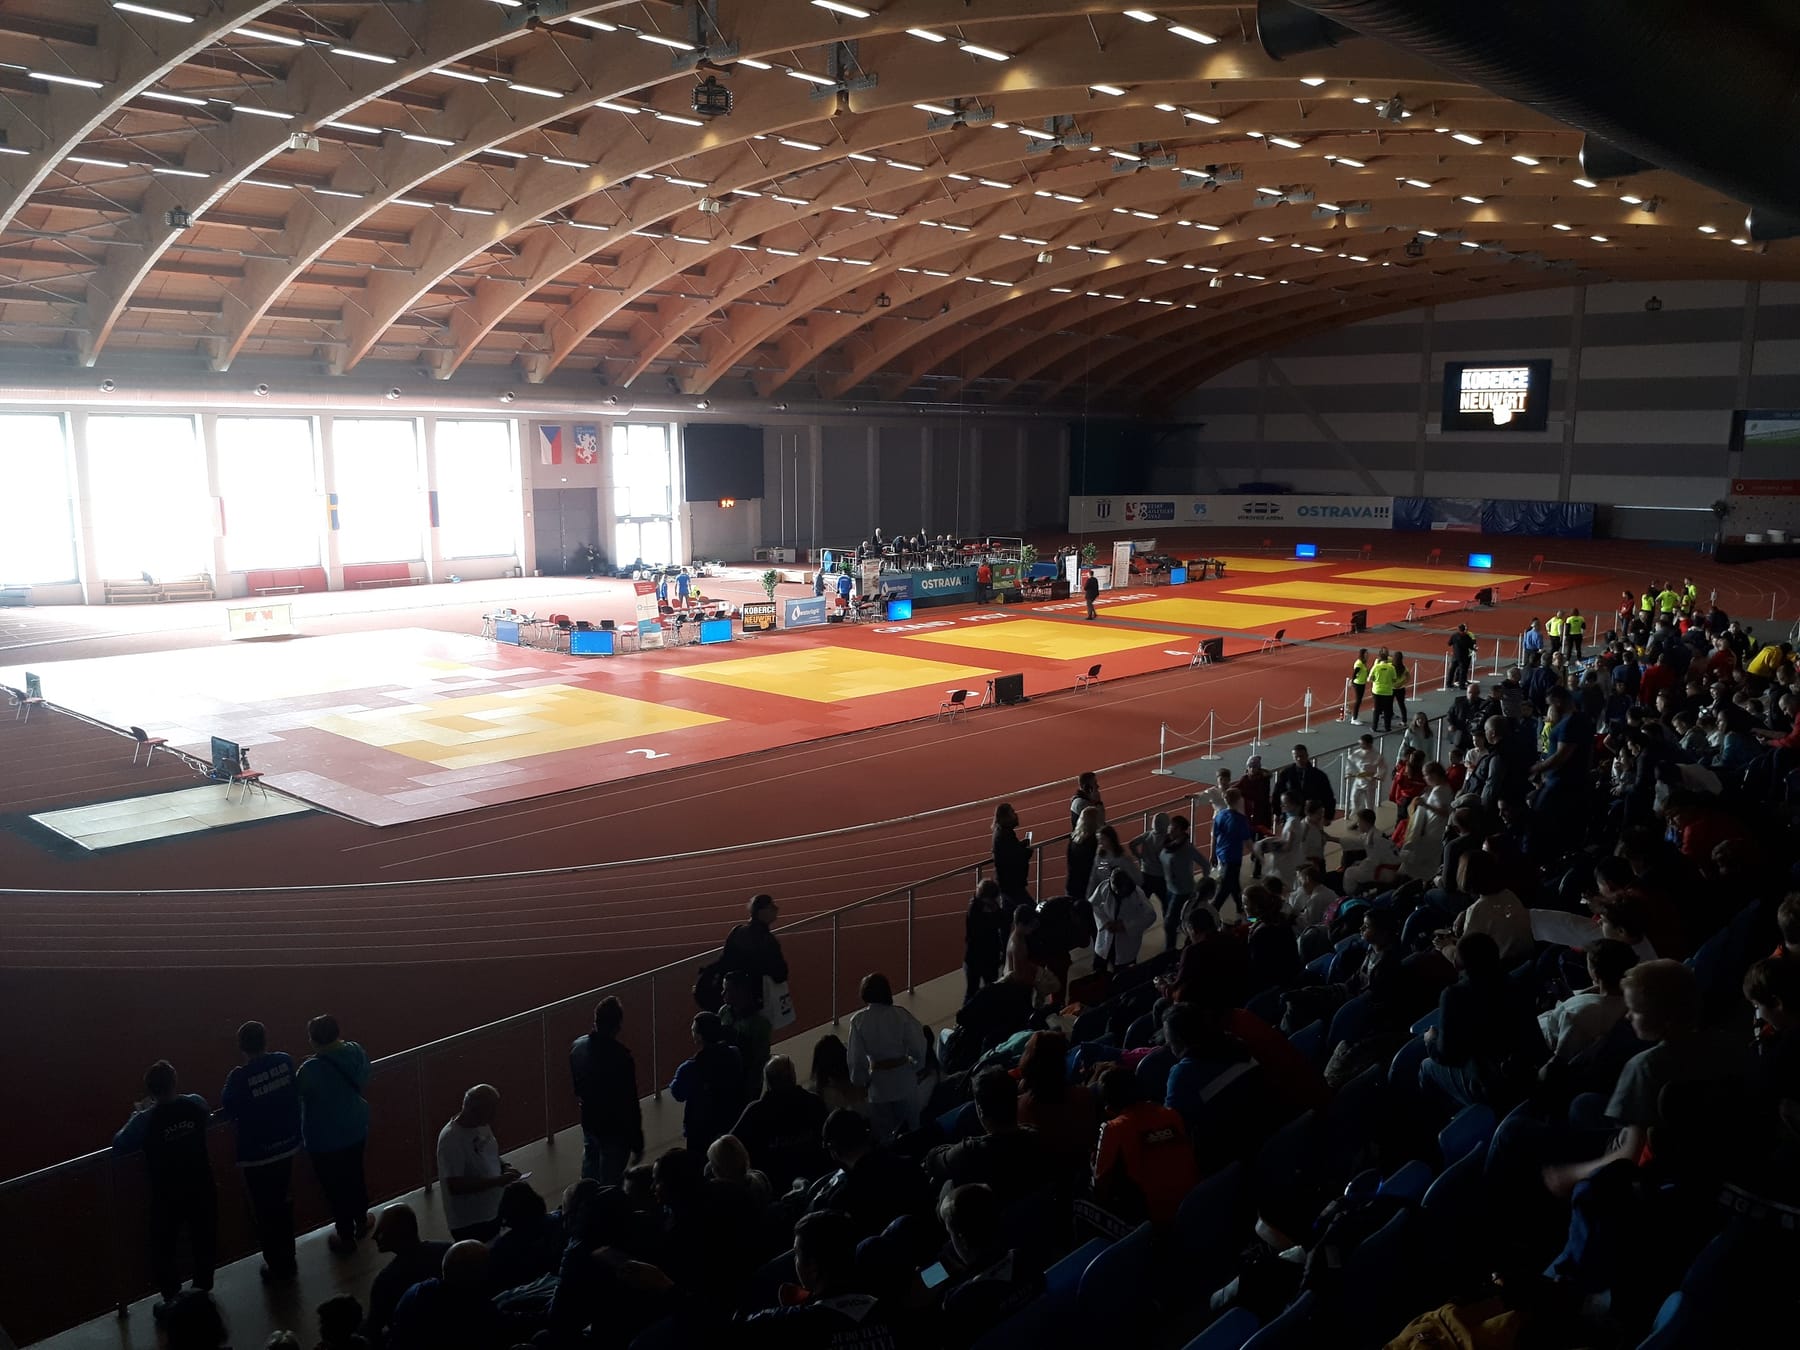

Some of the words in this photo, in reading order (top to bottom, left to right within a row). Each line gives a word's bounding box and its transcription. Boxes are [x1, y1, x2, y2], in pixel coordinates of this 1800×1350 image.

[1297, 505, 1389, 518] OSTRAVA!!!
[744, 605, 776, 615] KOBERCE
[625, 748, 672, 759] 2
